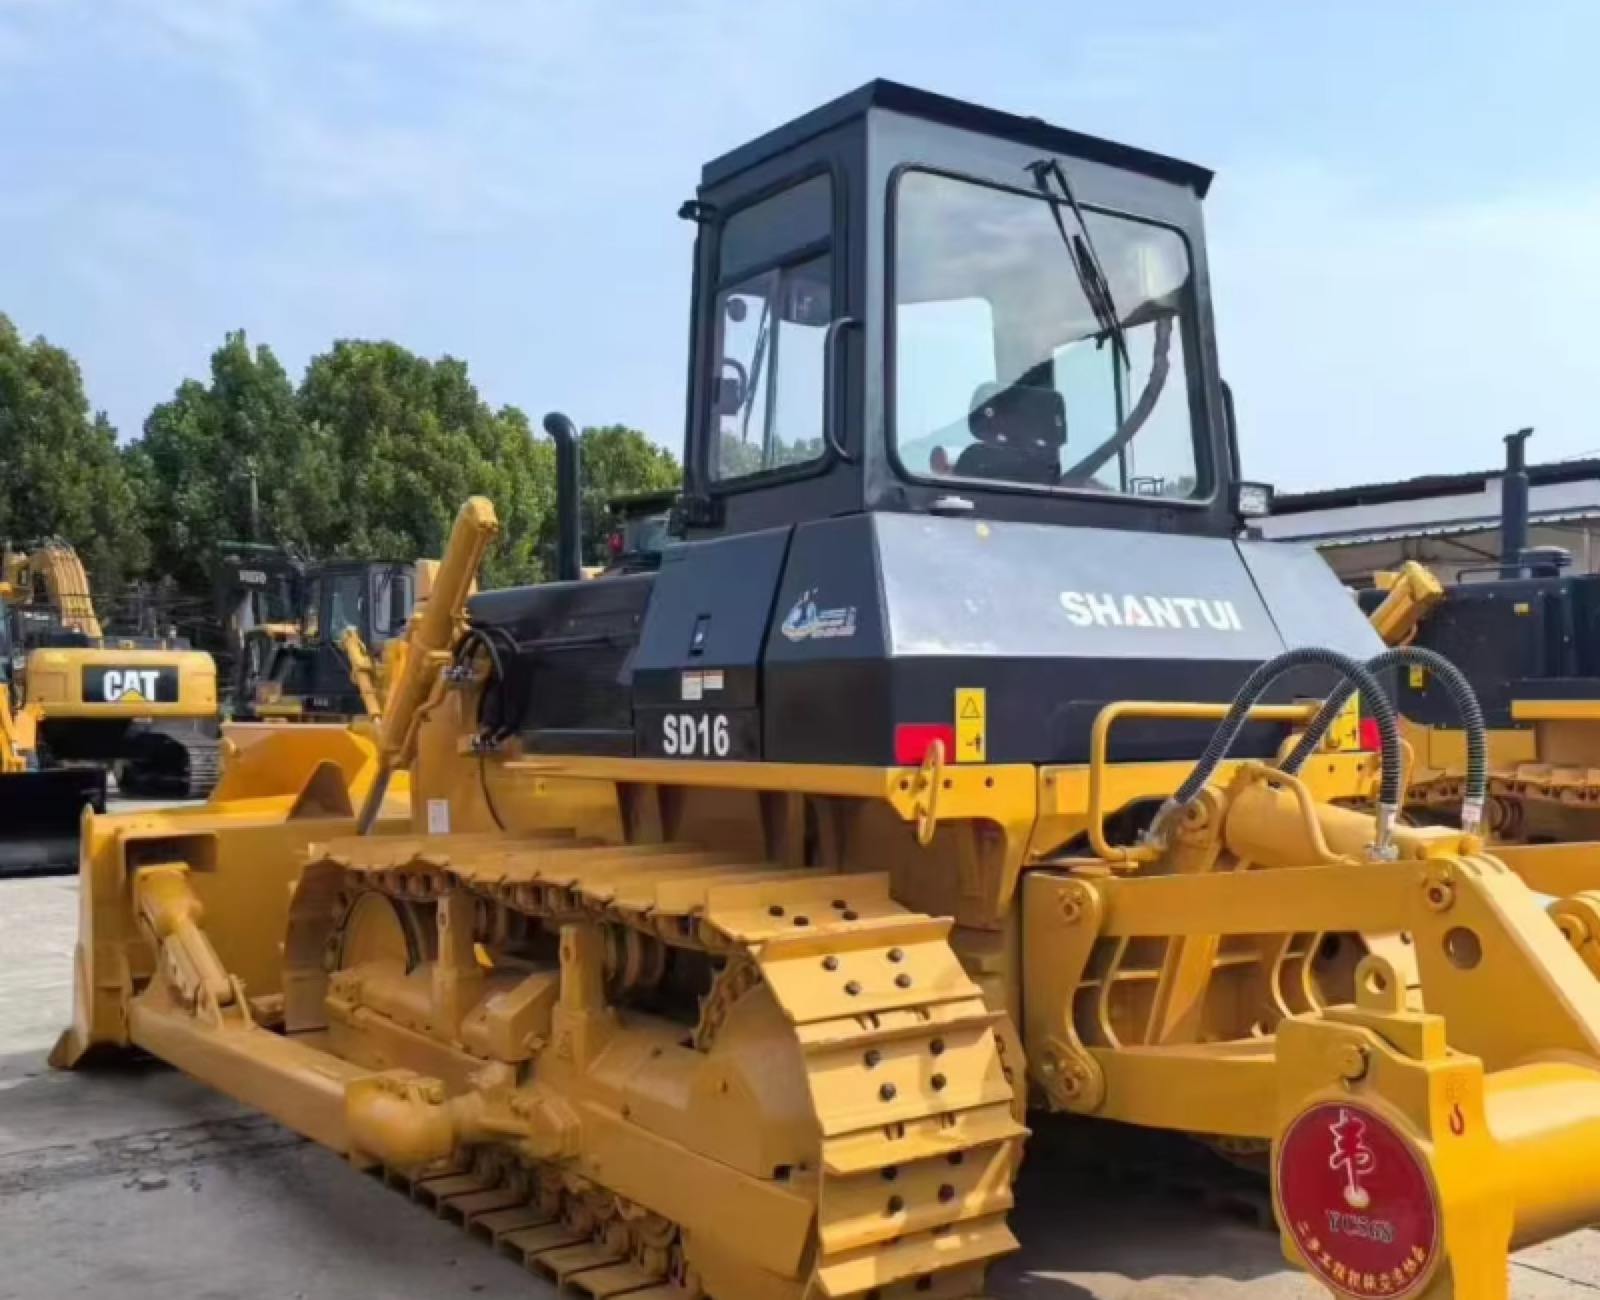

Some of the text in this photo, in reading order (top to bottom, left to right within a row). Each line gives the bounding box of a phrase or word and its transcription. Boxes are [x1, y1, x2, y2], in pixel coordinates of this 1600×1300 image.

[1060, 591, 1243, 631] SHANTUI
[103, 670, 160, 702] CAT
[663, 713, 730, 757] SD16
